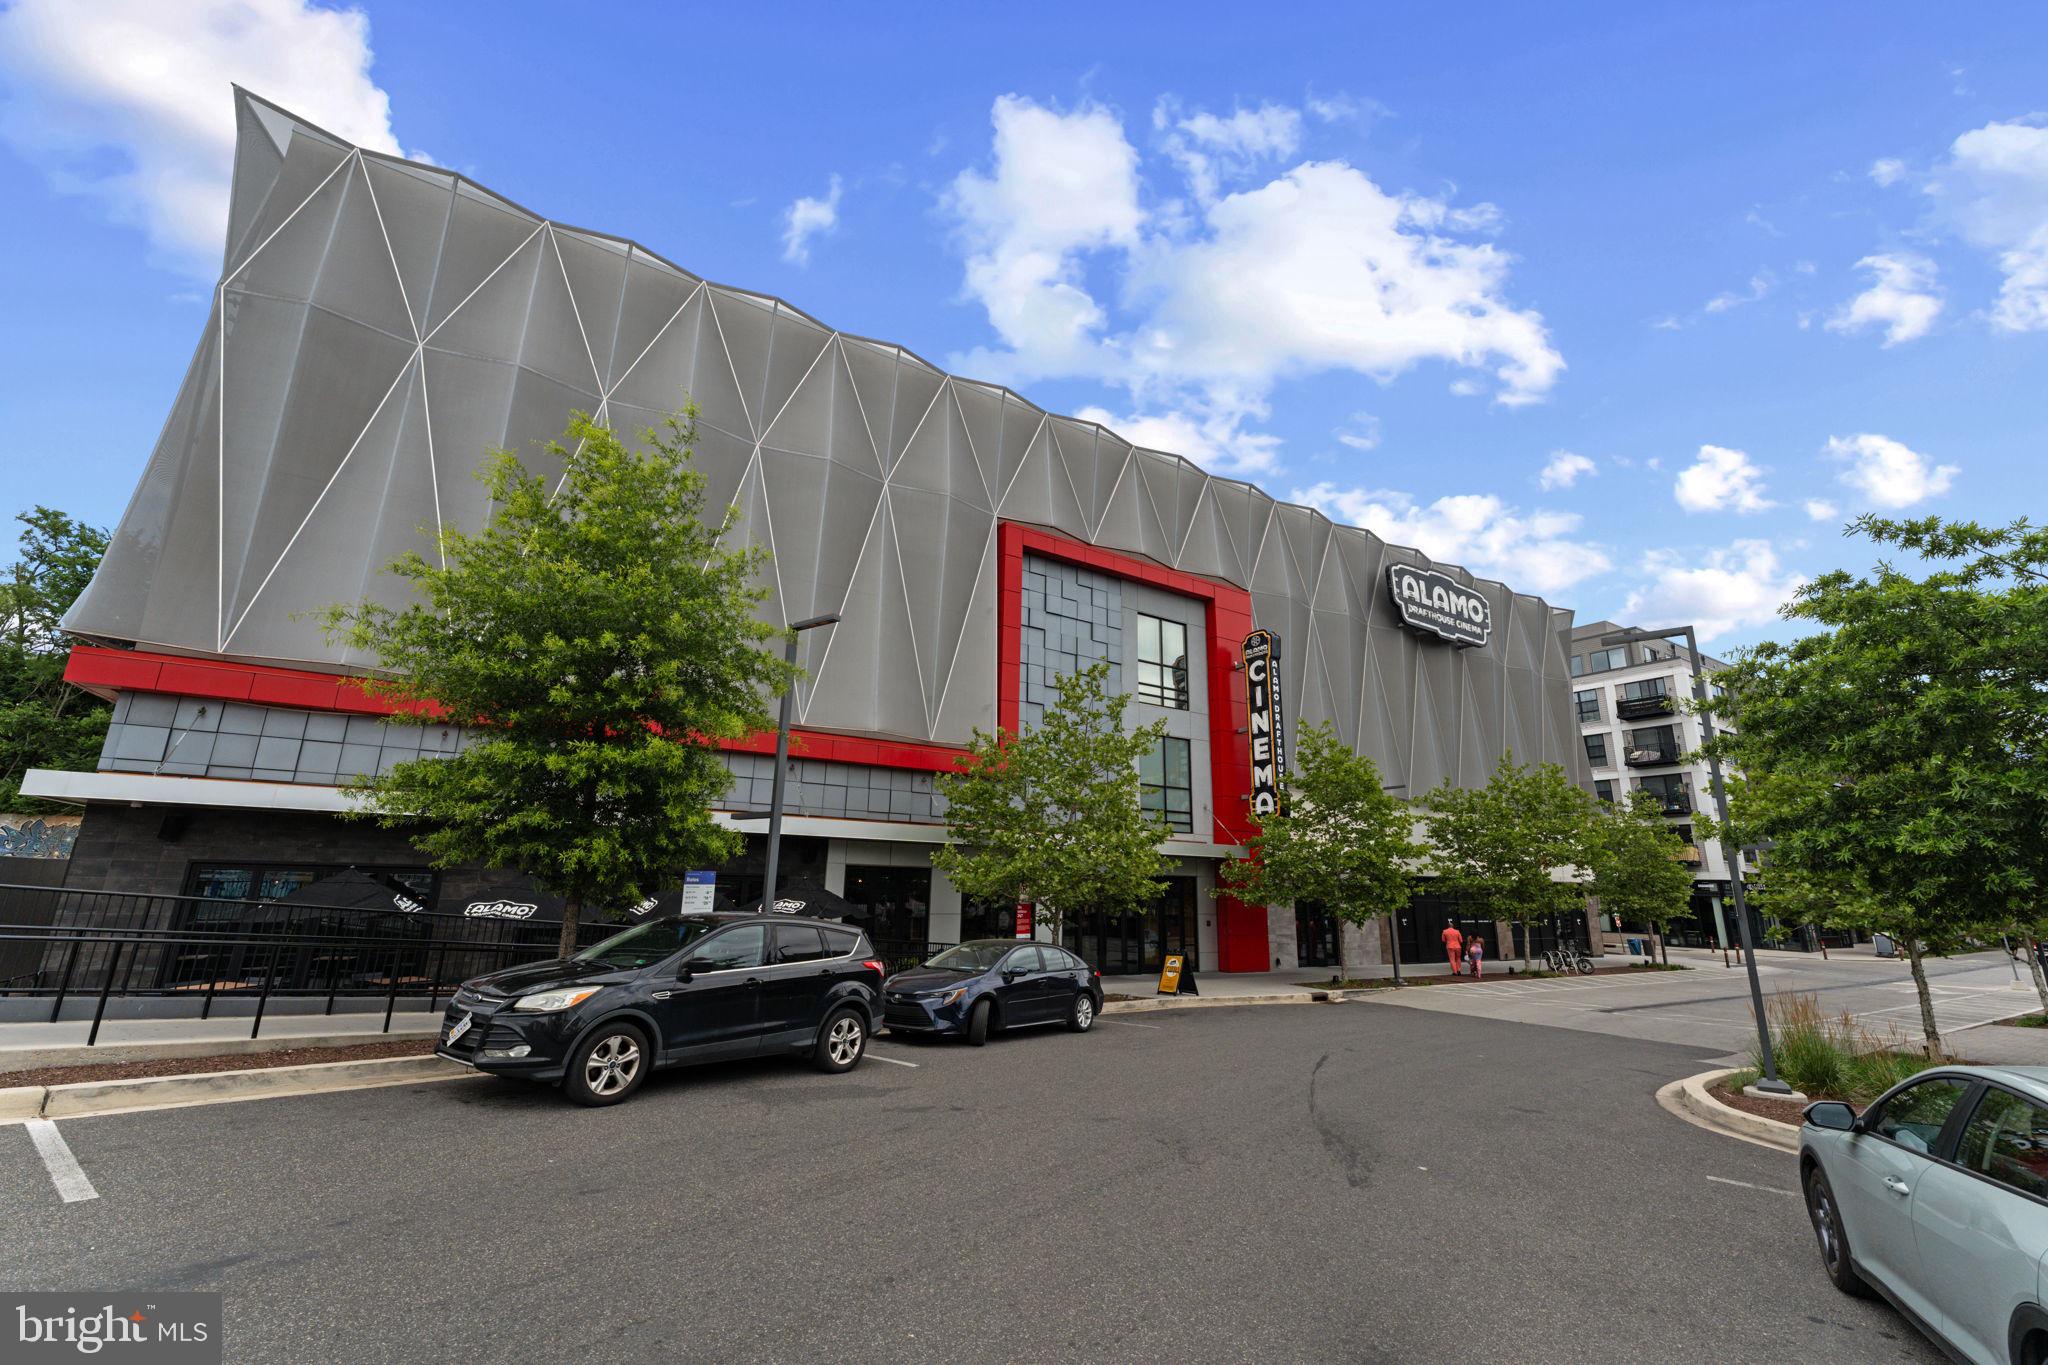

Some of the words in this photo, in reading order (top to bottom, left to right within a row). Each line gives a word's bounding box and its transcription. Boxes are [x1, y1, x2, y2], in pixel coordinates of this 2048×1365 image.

[1402, 574, 1484, 623] ALAMO
[1408, 604, 1455, 626] DRAFTHOUSE
[1456, 620, 1482, 635] CINEMA
[1271, 660, 1280, 701] ALAMO
[1249, 659, 1275, 816] CINEMA
[471, 903, 529, 915] ALAMO
